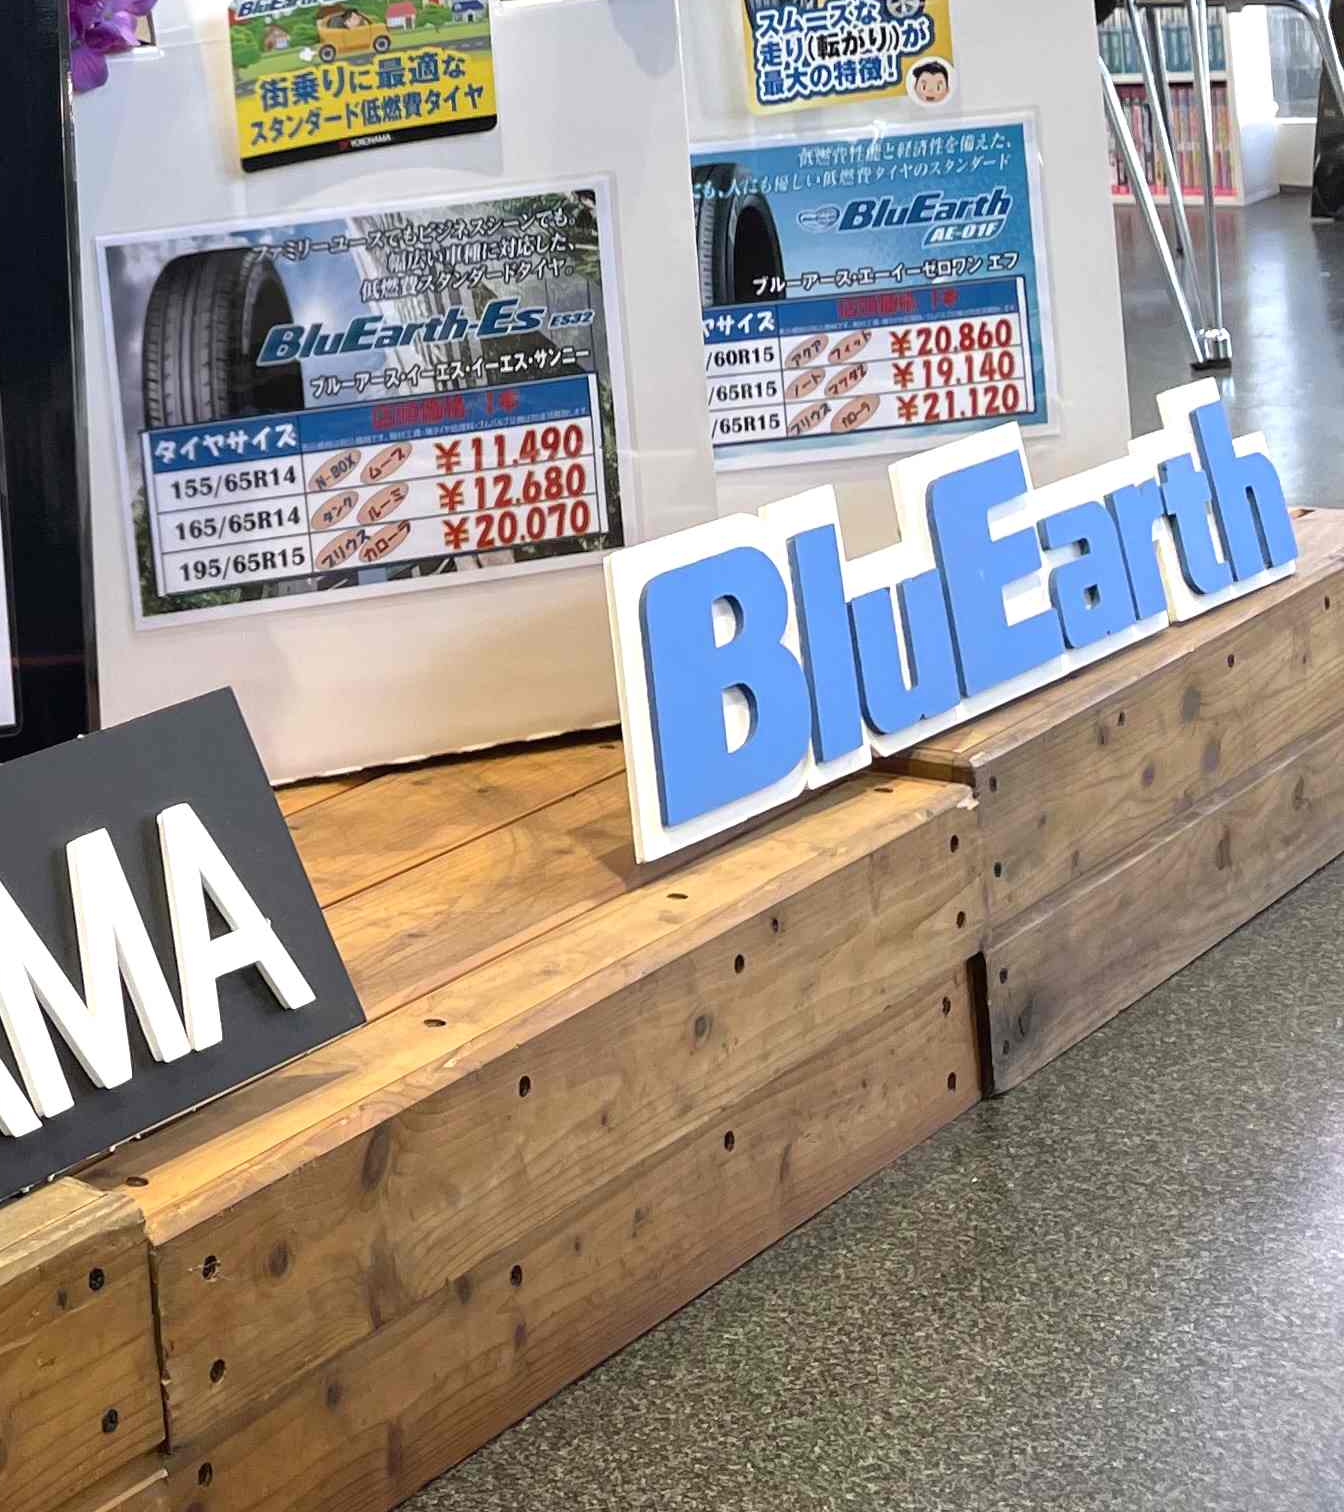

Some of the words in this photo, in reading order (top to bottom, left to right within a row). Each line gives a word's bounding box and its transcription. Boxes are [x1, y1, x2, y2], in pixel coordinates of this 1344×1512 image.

[258, 51, 467, 113] 街乗りに最適な
[249, 83, 485, 146] スタンダード低燃費タイヤ
[839, 186, 1013, 234] BluEarth
[256, 298, 548, 367] BluEarth-Es
[548, 309, 596, 331] ES32
[153, 422, 298, 465] タイヤサイズ
[170, 465, 297, 501] 155/65R14
[315, 454, 357, 491] N-BOX
[175, 505, 302, 542] 165/65R14
[178, 545, 307, 584] 195/65R15
[639, 400, 1299, 828] BluEarth
